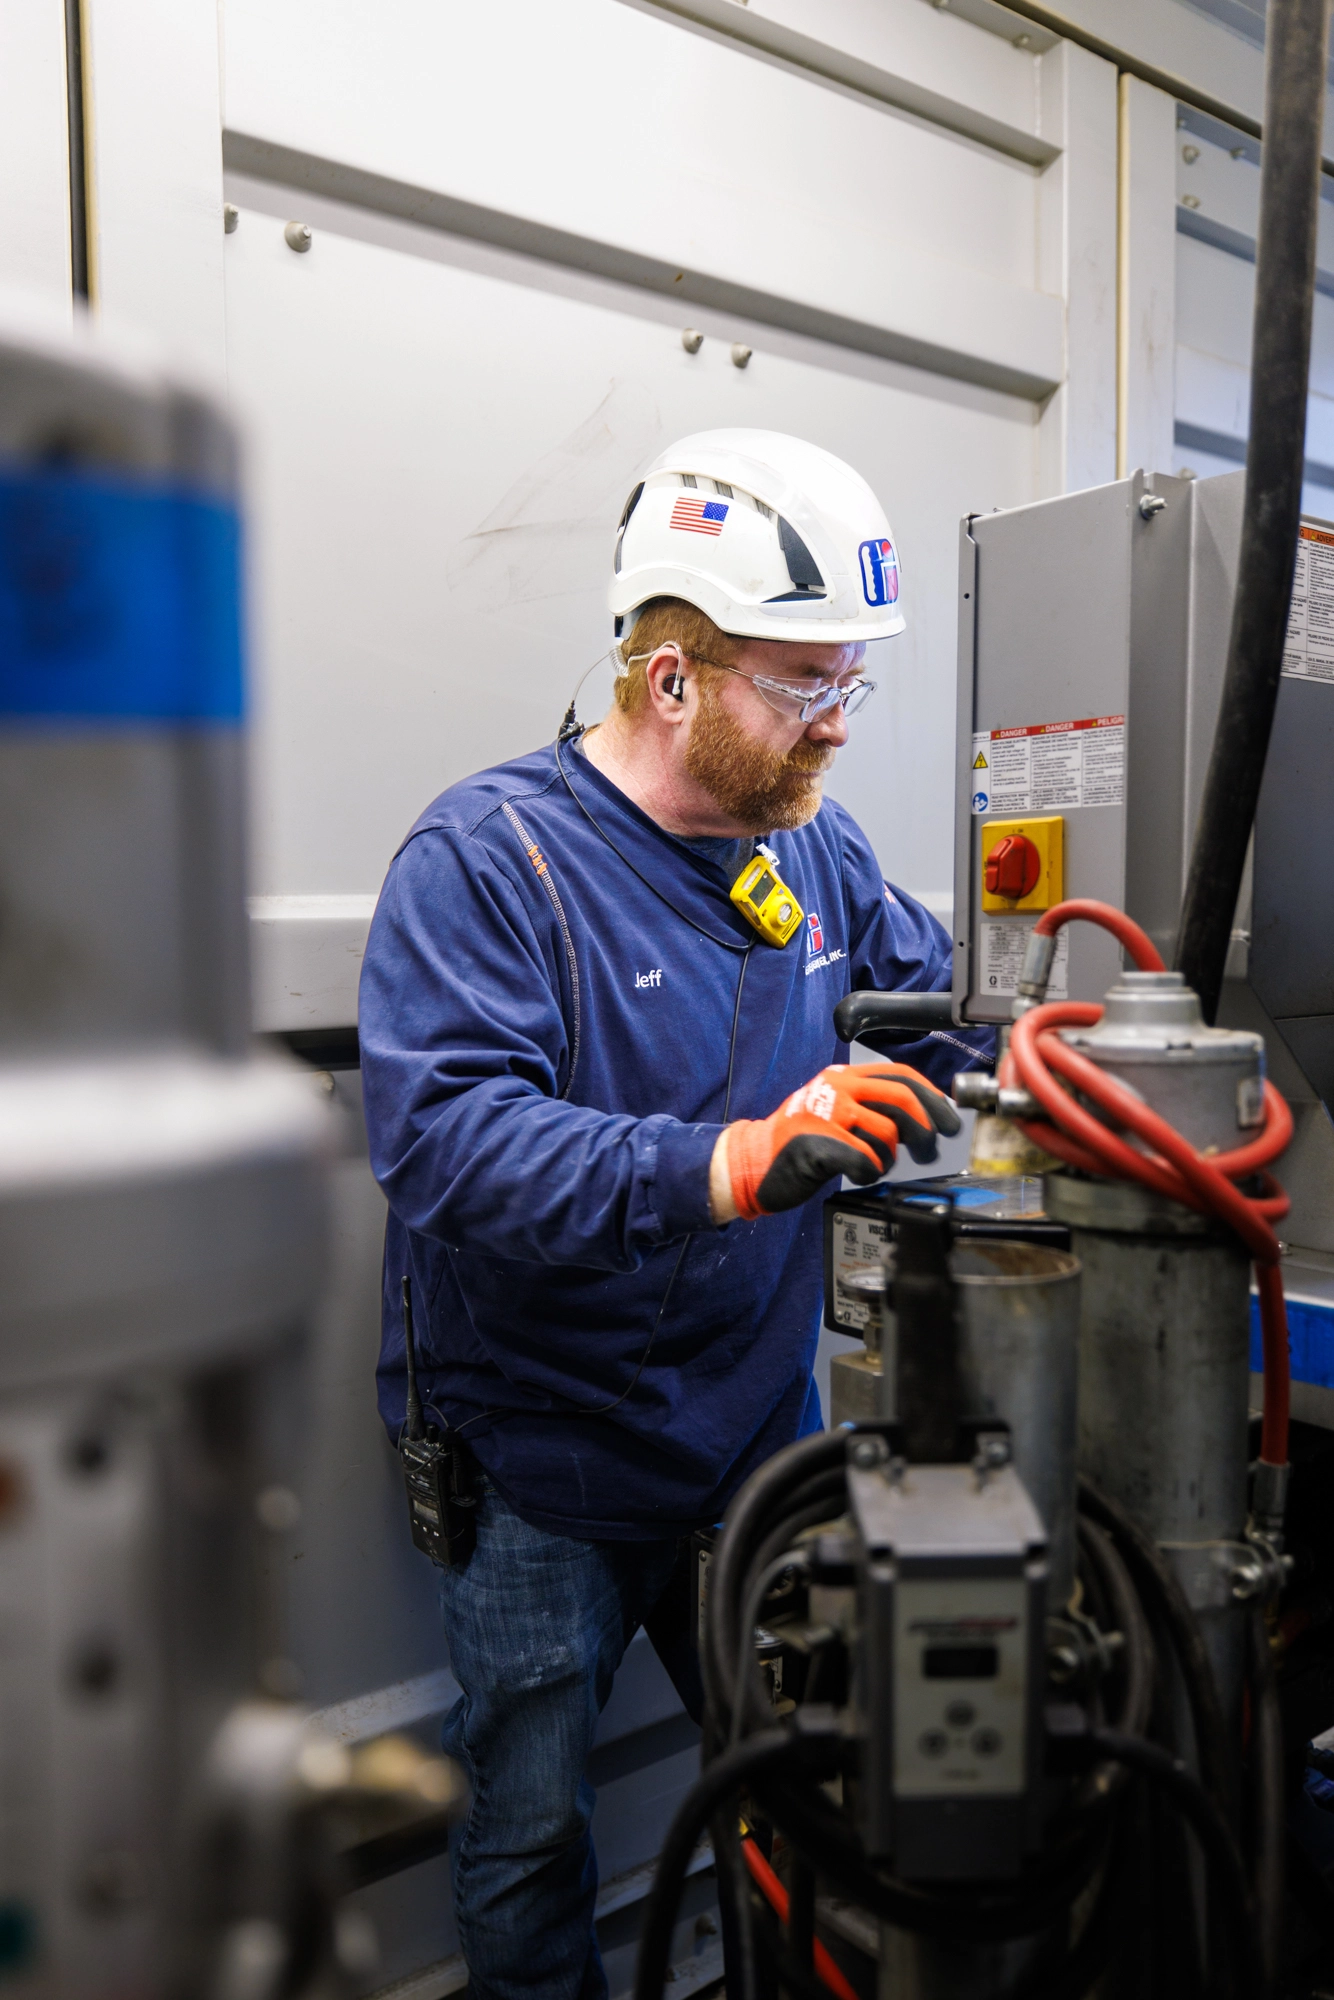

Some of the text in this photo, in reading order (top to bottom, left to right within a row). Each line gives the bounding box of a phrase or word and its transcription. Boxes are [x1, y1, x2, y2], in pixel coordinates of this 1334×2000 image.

[1045, 722, 1074, 732] DANGER
[1000, 728, 1027, 738] DANGER
[829, 949, 847, 962] INC.
[635, 969, 662, 988] Jeff
